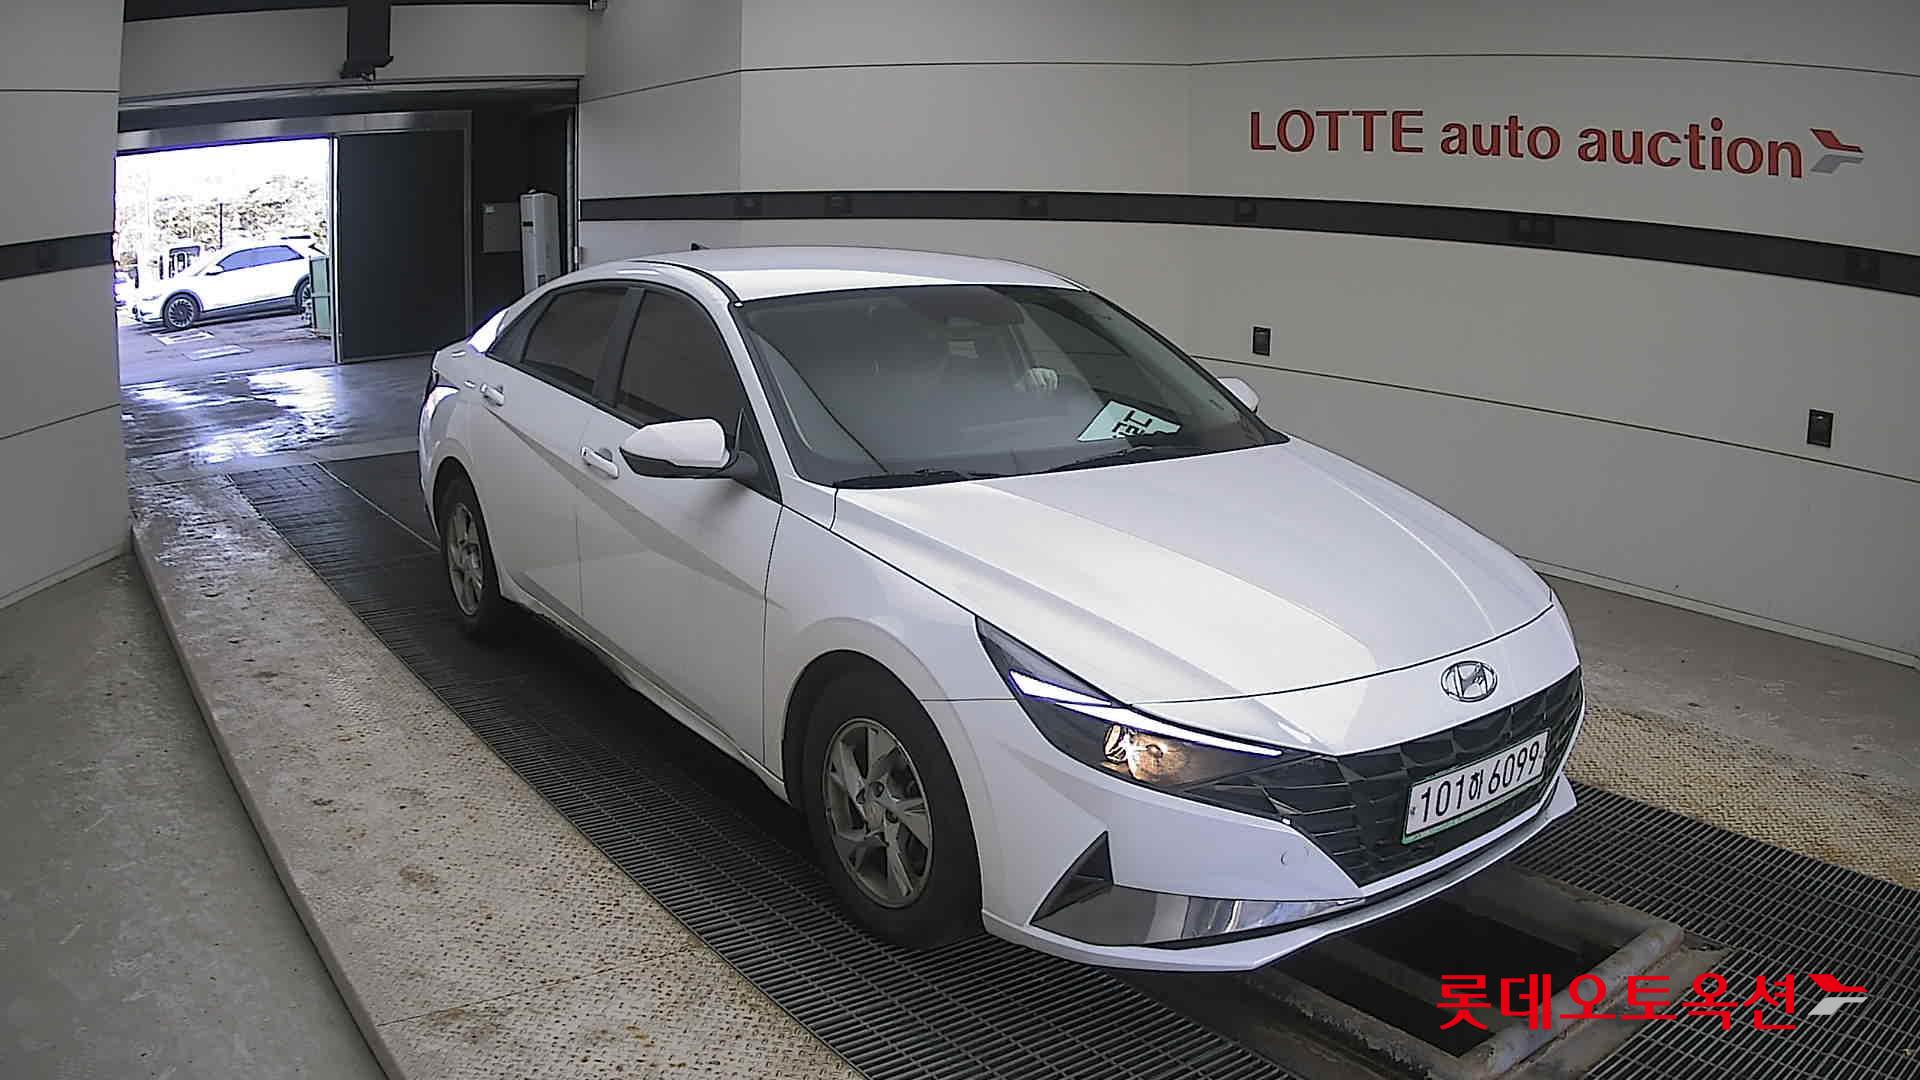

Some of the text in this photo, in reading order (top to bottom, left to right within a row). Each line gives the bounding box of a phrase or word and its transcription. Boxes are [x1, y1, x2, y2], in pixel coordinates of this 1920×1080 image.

[1250, 109, 1803, 179] LOTTE auto auction
